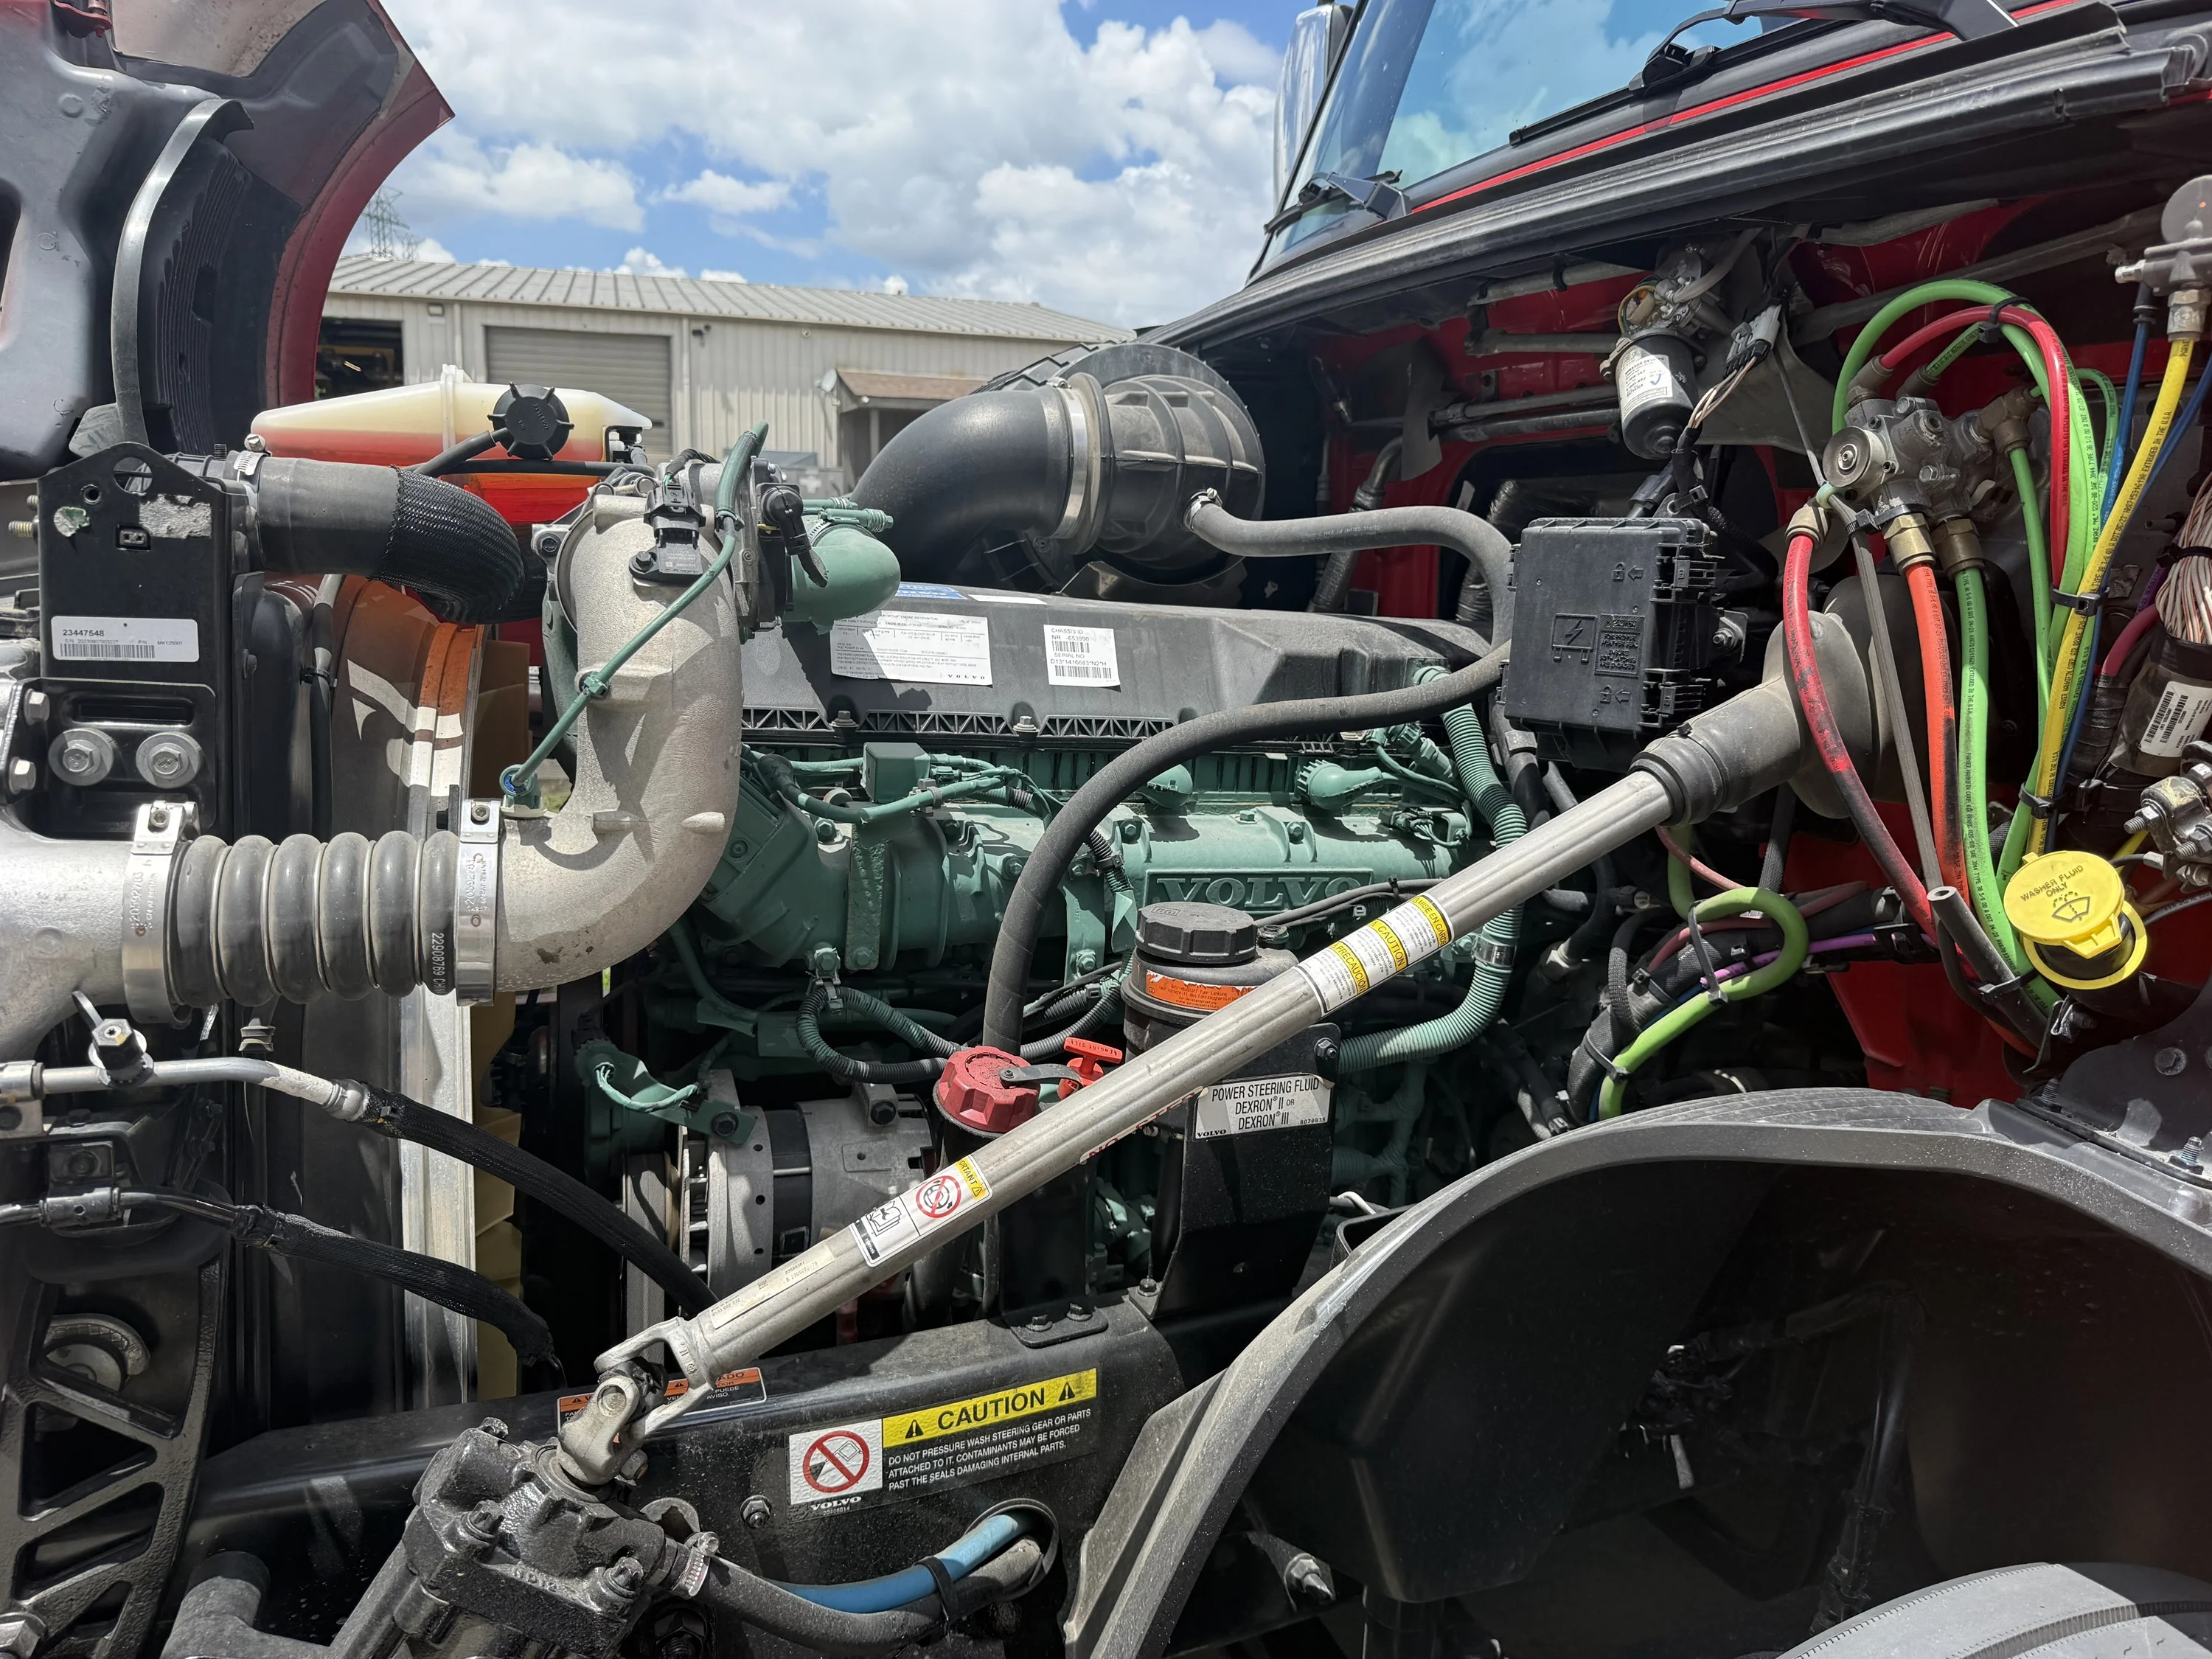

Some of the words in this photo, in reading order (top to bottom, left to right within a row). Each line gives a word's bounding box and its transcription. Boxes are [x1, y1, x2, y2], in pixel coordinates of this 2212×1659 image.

[2180, 340, 2191, 357] PARKE
[2142, 445, 2158, 472] EXTRUDED
[2059, 694, 2068, 709] PARKER
[1157, 877, 1362, 908] VOLVO
[2020, 878, 2057, 902] WASHER
[2059, 865, 2084, 881] FLUID
[2046, 882, 2068, 897] ONLY
[1429, 912, 1440, 925] EN
[432, 933, 445, 979] 22908769
[1378, 926, 1405, 967] CAUTION
[1335, 942, 1369, 992] PRECAUCIÓN
[1212, 1085, 1245, 1102] POWER
[1248, 1081, 1292, 1098] STEERING
[1294, 1077, 1319, 1093] FLUID
[1279, 1099, 1284, 1110] II
[1281, 1112, 1290, 1125] III
[1300, 1117, 1326, 1125] 8079835
[1197, 1129, 1227, 1138] VOLVO
[959, 1160, 978, 1185] ORTANT
[706, 1392, 730, 1400] AVISO.
[714, 1385, 740, 1394] PUEDE
[938, 1387, 1046, 1430] CAUTION
[889, 1455, 902, 1467] DO
[903, 1451, 921, 1464] NOT
[922, 1441, 966, 1461] PRESSURE
[967, 1436, 991, 1451] WASH
[992, 1425, 1031, 1444] STEERING
[1032, 1419, 1053, 1434] GEAR
[1054, 1417, 1065, 1428] OR
[1068, 1408, 1091, 1425] PARTS
[888, 1461, 931, 1479] ATTACHED
[933, 1458, 945, 1470] TO
[956, 1441, 1018, 1464] CONTAMINANTS
[1019, 1435, 1036, 1450] MAY
[1037, 1433, 1048, 1444] BE
[1049, 1423, 1080, 1442] FORCED
[889, 1478, 909, 1492] PAST
[911, 1475, 928, 1487] THE
[929, 1468, 956, 1484] SEALS
[957, 1458, 1000, 1477] DAMAGING
[1001, 1448, 1039, 1467] INTERNAL
[1040, 1440, 1067, 1458] PARTS.
[810, 1496, 862, 1511] VOLVO
